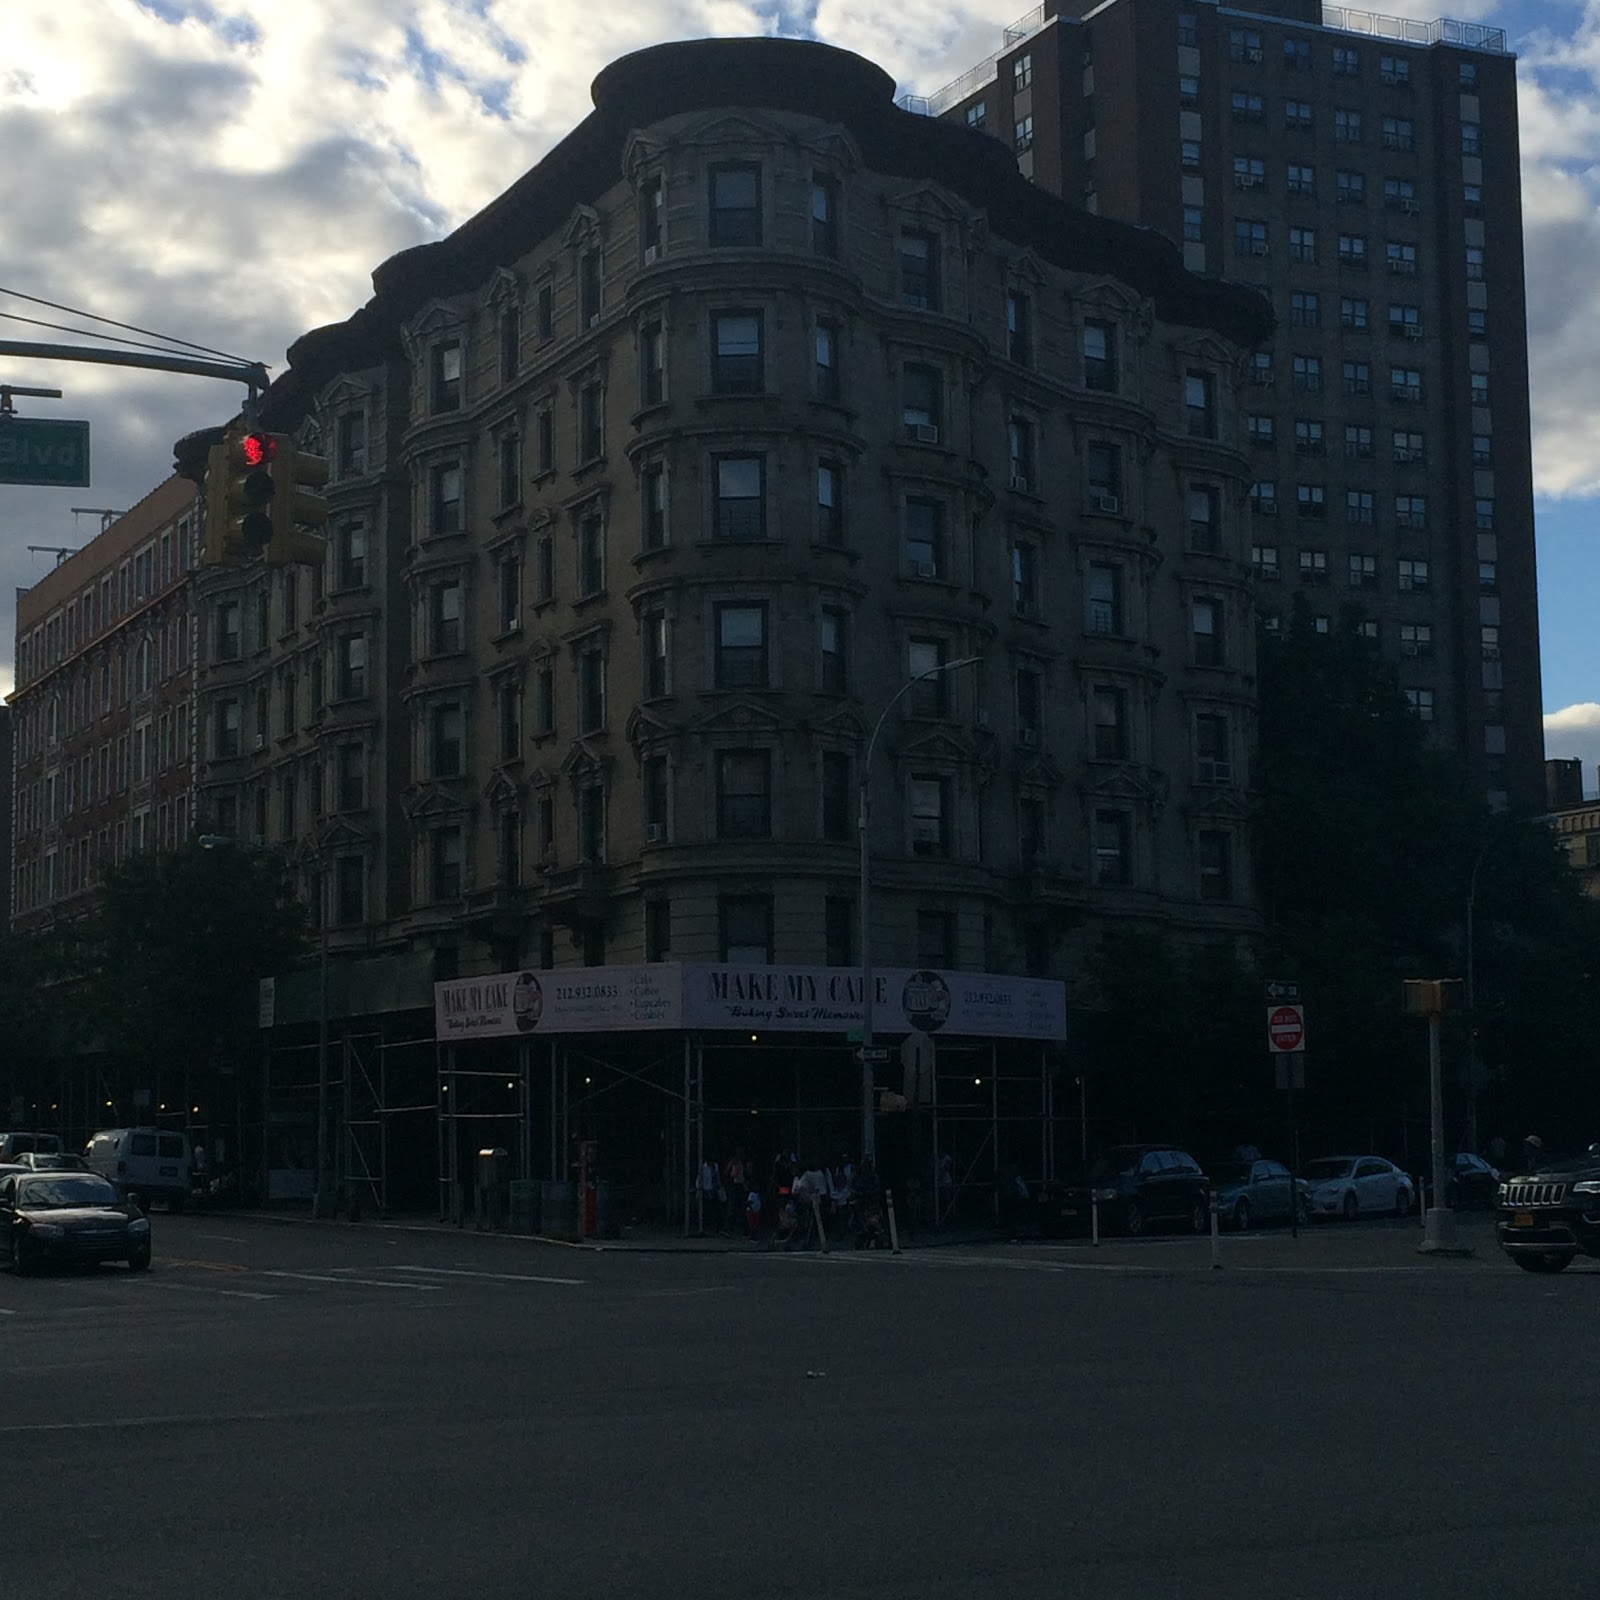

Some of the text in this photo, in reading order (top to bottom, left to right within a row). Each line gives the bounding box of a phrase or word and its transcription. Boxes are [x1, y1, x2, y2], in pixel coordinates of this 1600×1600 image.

[485, 982, 508, 1012] CAKE
[710, 972, 778, 1001] MAKE
[785, 974, 818, 1002] MY
[775, 1006, 808, 1020] Sweet
[810, 1006, 864, 1021] Memorie
